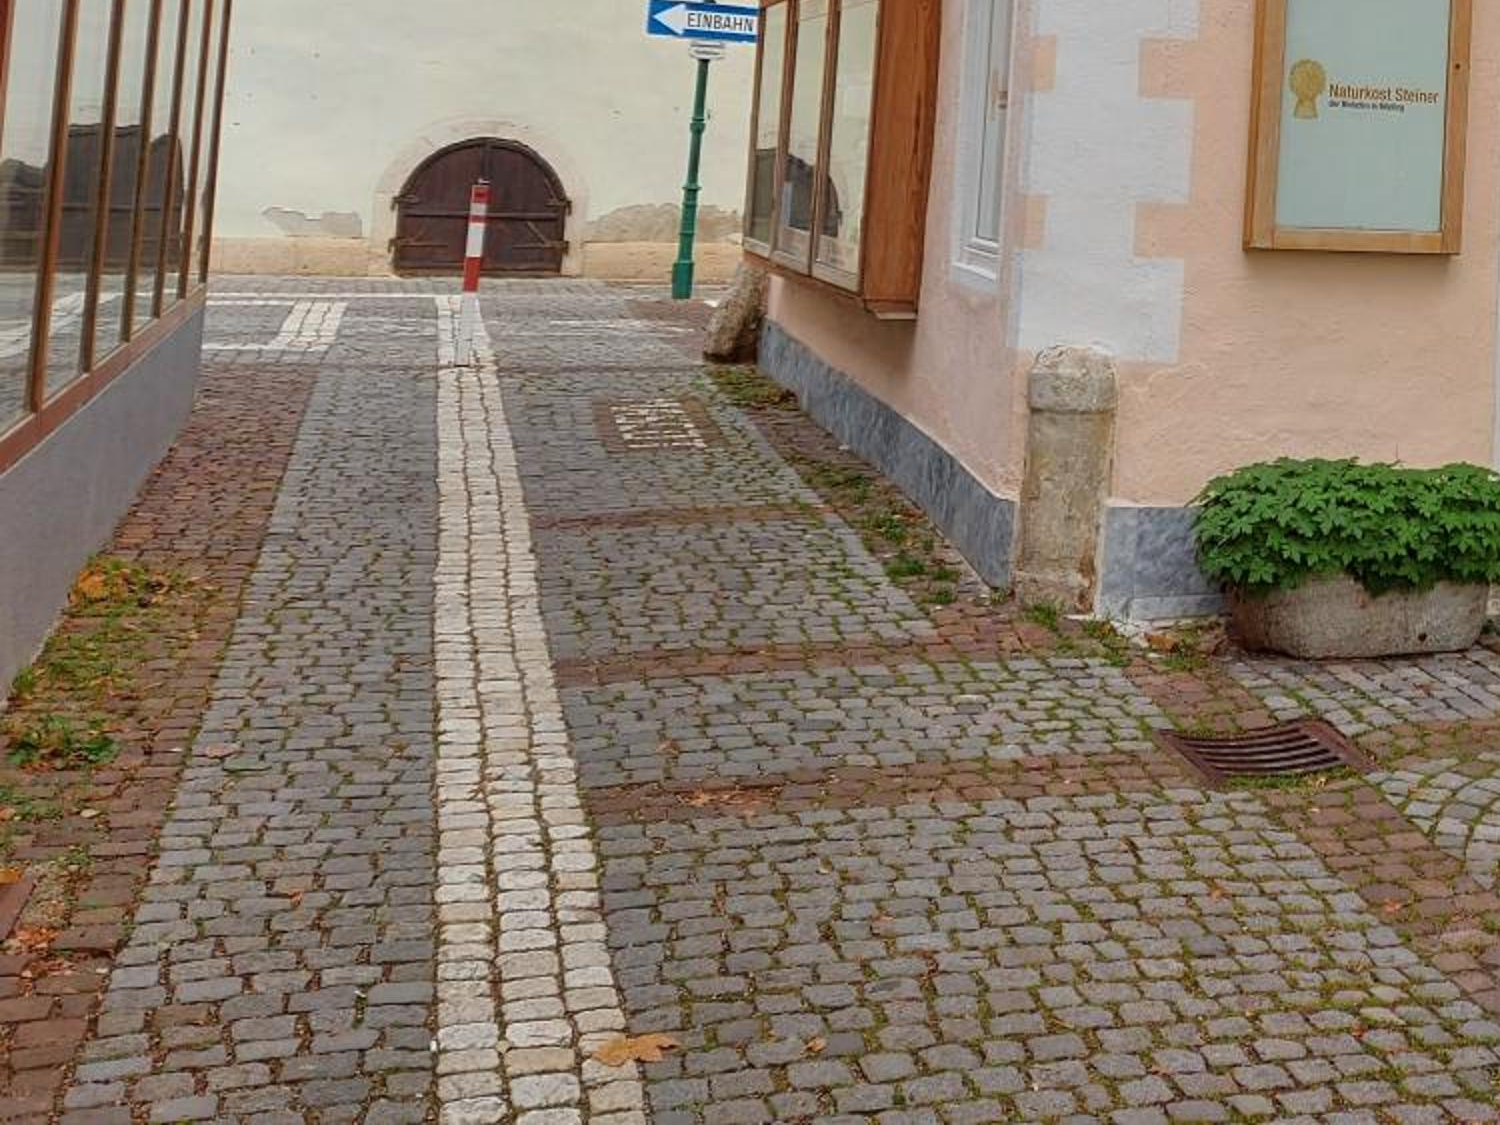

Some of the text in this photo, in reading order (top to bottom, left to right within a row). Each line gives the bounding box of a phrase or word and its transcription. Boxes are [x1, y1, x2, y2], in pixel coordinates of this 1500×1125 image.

[687, 12, 754, 32] EINBAHN
[1329, 83, 1440, 104] Naturkost Steiner
